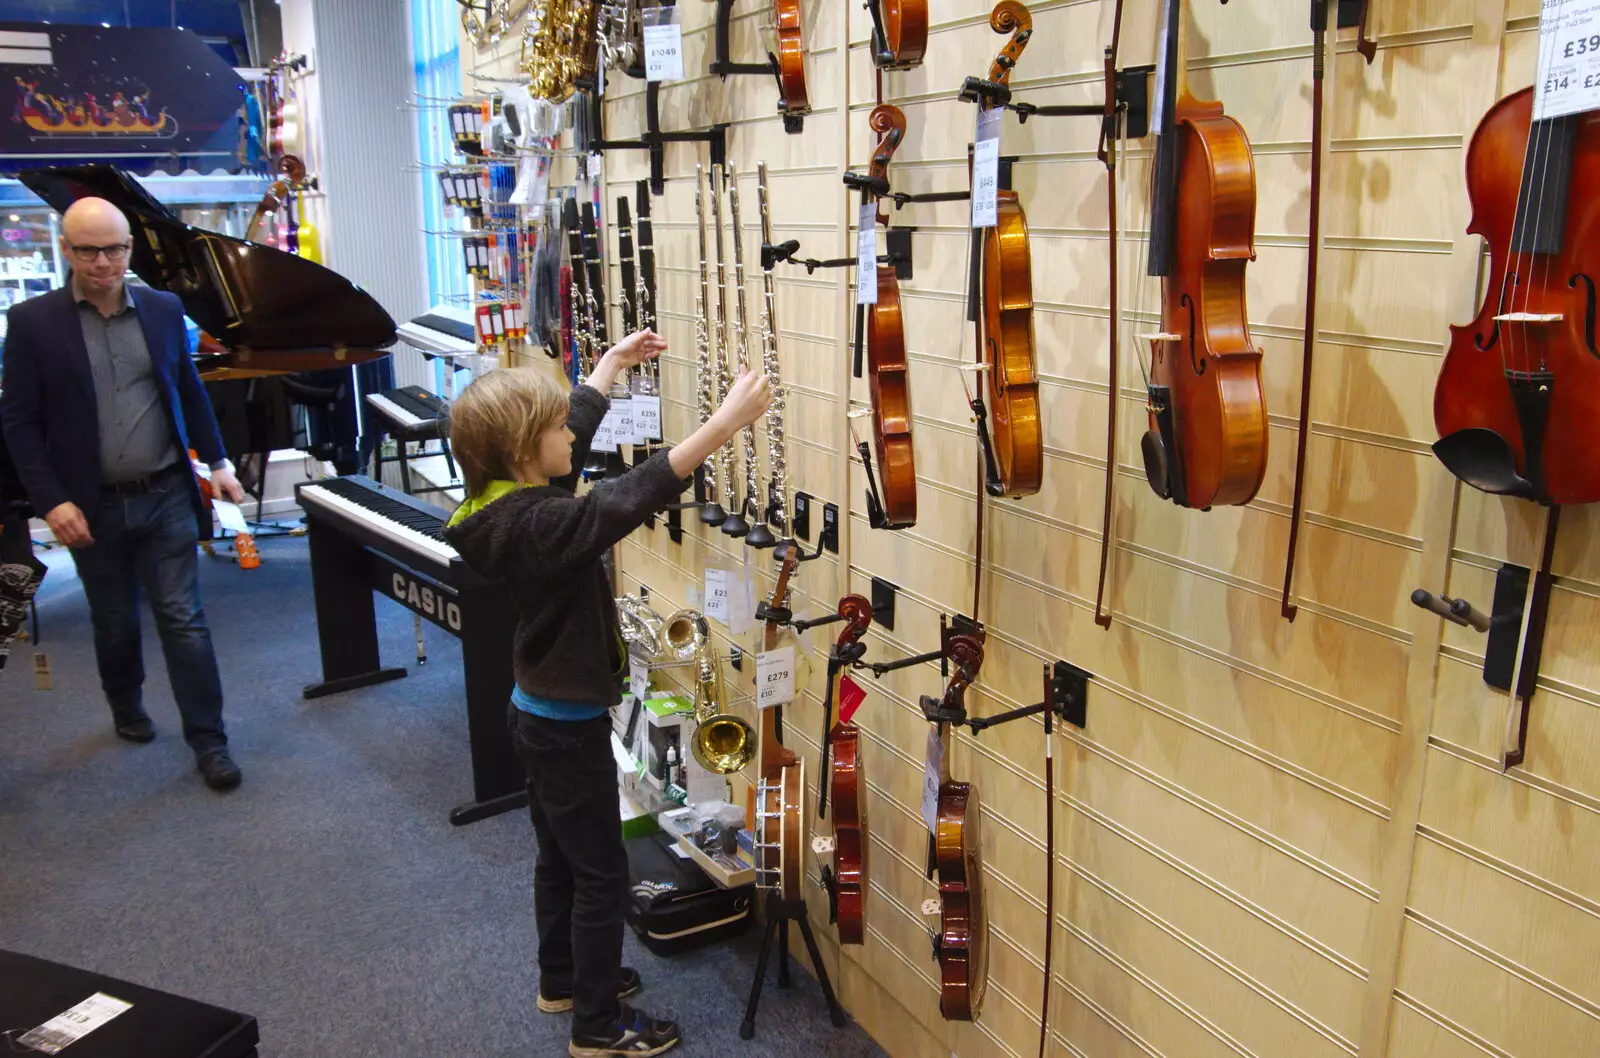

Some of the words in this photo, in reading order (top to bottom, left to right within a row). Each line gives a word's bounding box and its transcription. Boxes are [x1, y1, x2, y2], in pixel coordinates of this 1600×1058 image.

[651, 48, 676, 56] £1049
[1563, 34, 1600, 58] £39
[1543, 76, 1569, 93] £14
[641, 410, 657, 418] £239
[393, 572, 462, 631] CASIO
[767, 670, 789, 683] £279
